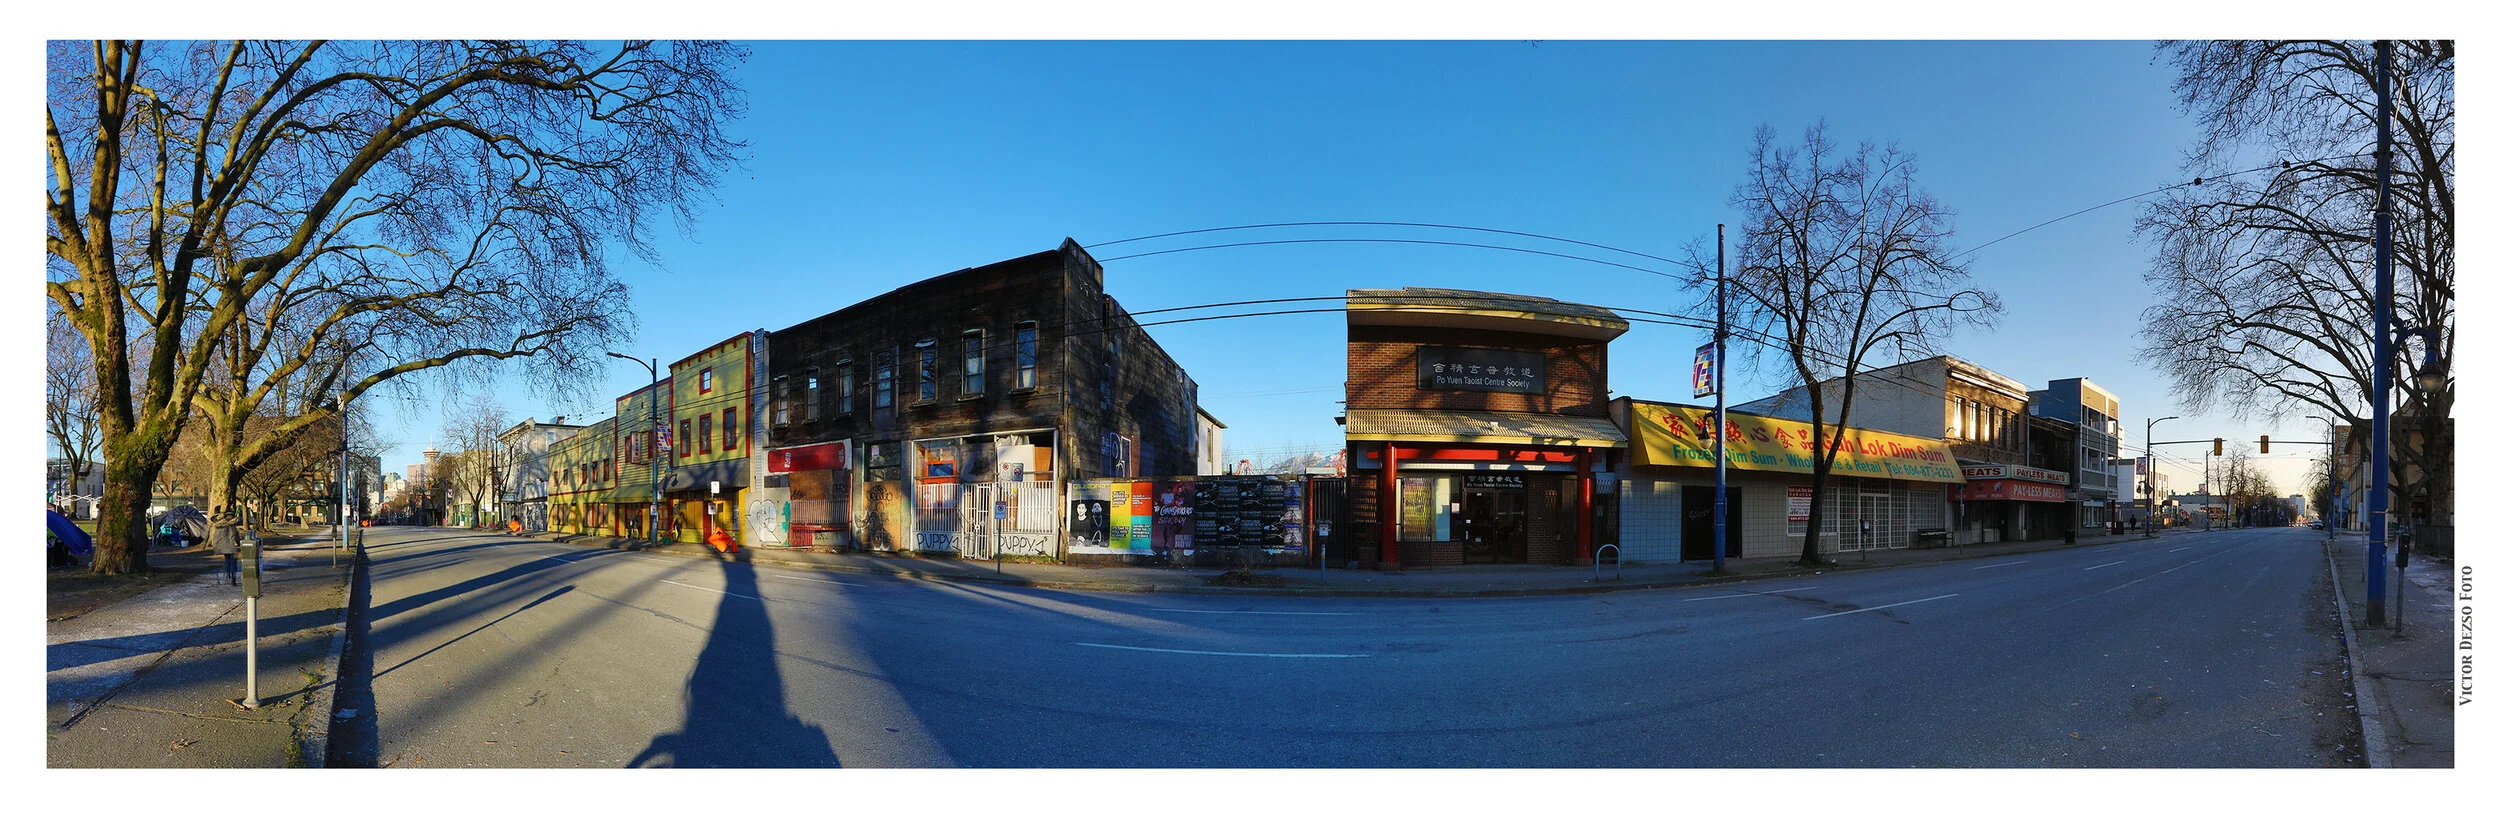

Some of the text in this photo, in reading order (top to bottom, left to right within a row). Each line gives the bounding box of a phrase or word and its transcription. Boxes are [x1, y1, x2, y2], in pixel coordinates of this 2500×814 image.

[1436, 375, 1530, 389] Po Yuen Taoist Centre Society
[1856, 437, 1888, 457] Lok
[1888, 441, 1917, 460] Dim
[1917, 445, 1946, 463] Sum
[1750, 450, 1777, 465] Sum
[1845, 458, 1852, 471] &
[1854, 459, 1882, 473] Retail
[1886, 463, 1902, 475] Tel:
[1903, 465, 1955, 479] 604-873-2233
[2016, 468, 2066, 482] PAYLESS MEATS
[2013, 484, 2061, 499] PAY-LESS MEATS
[1175, 540, 1192, 548] NOW
